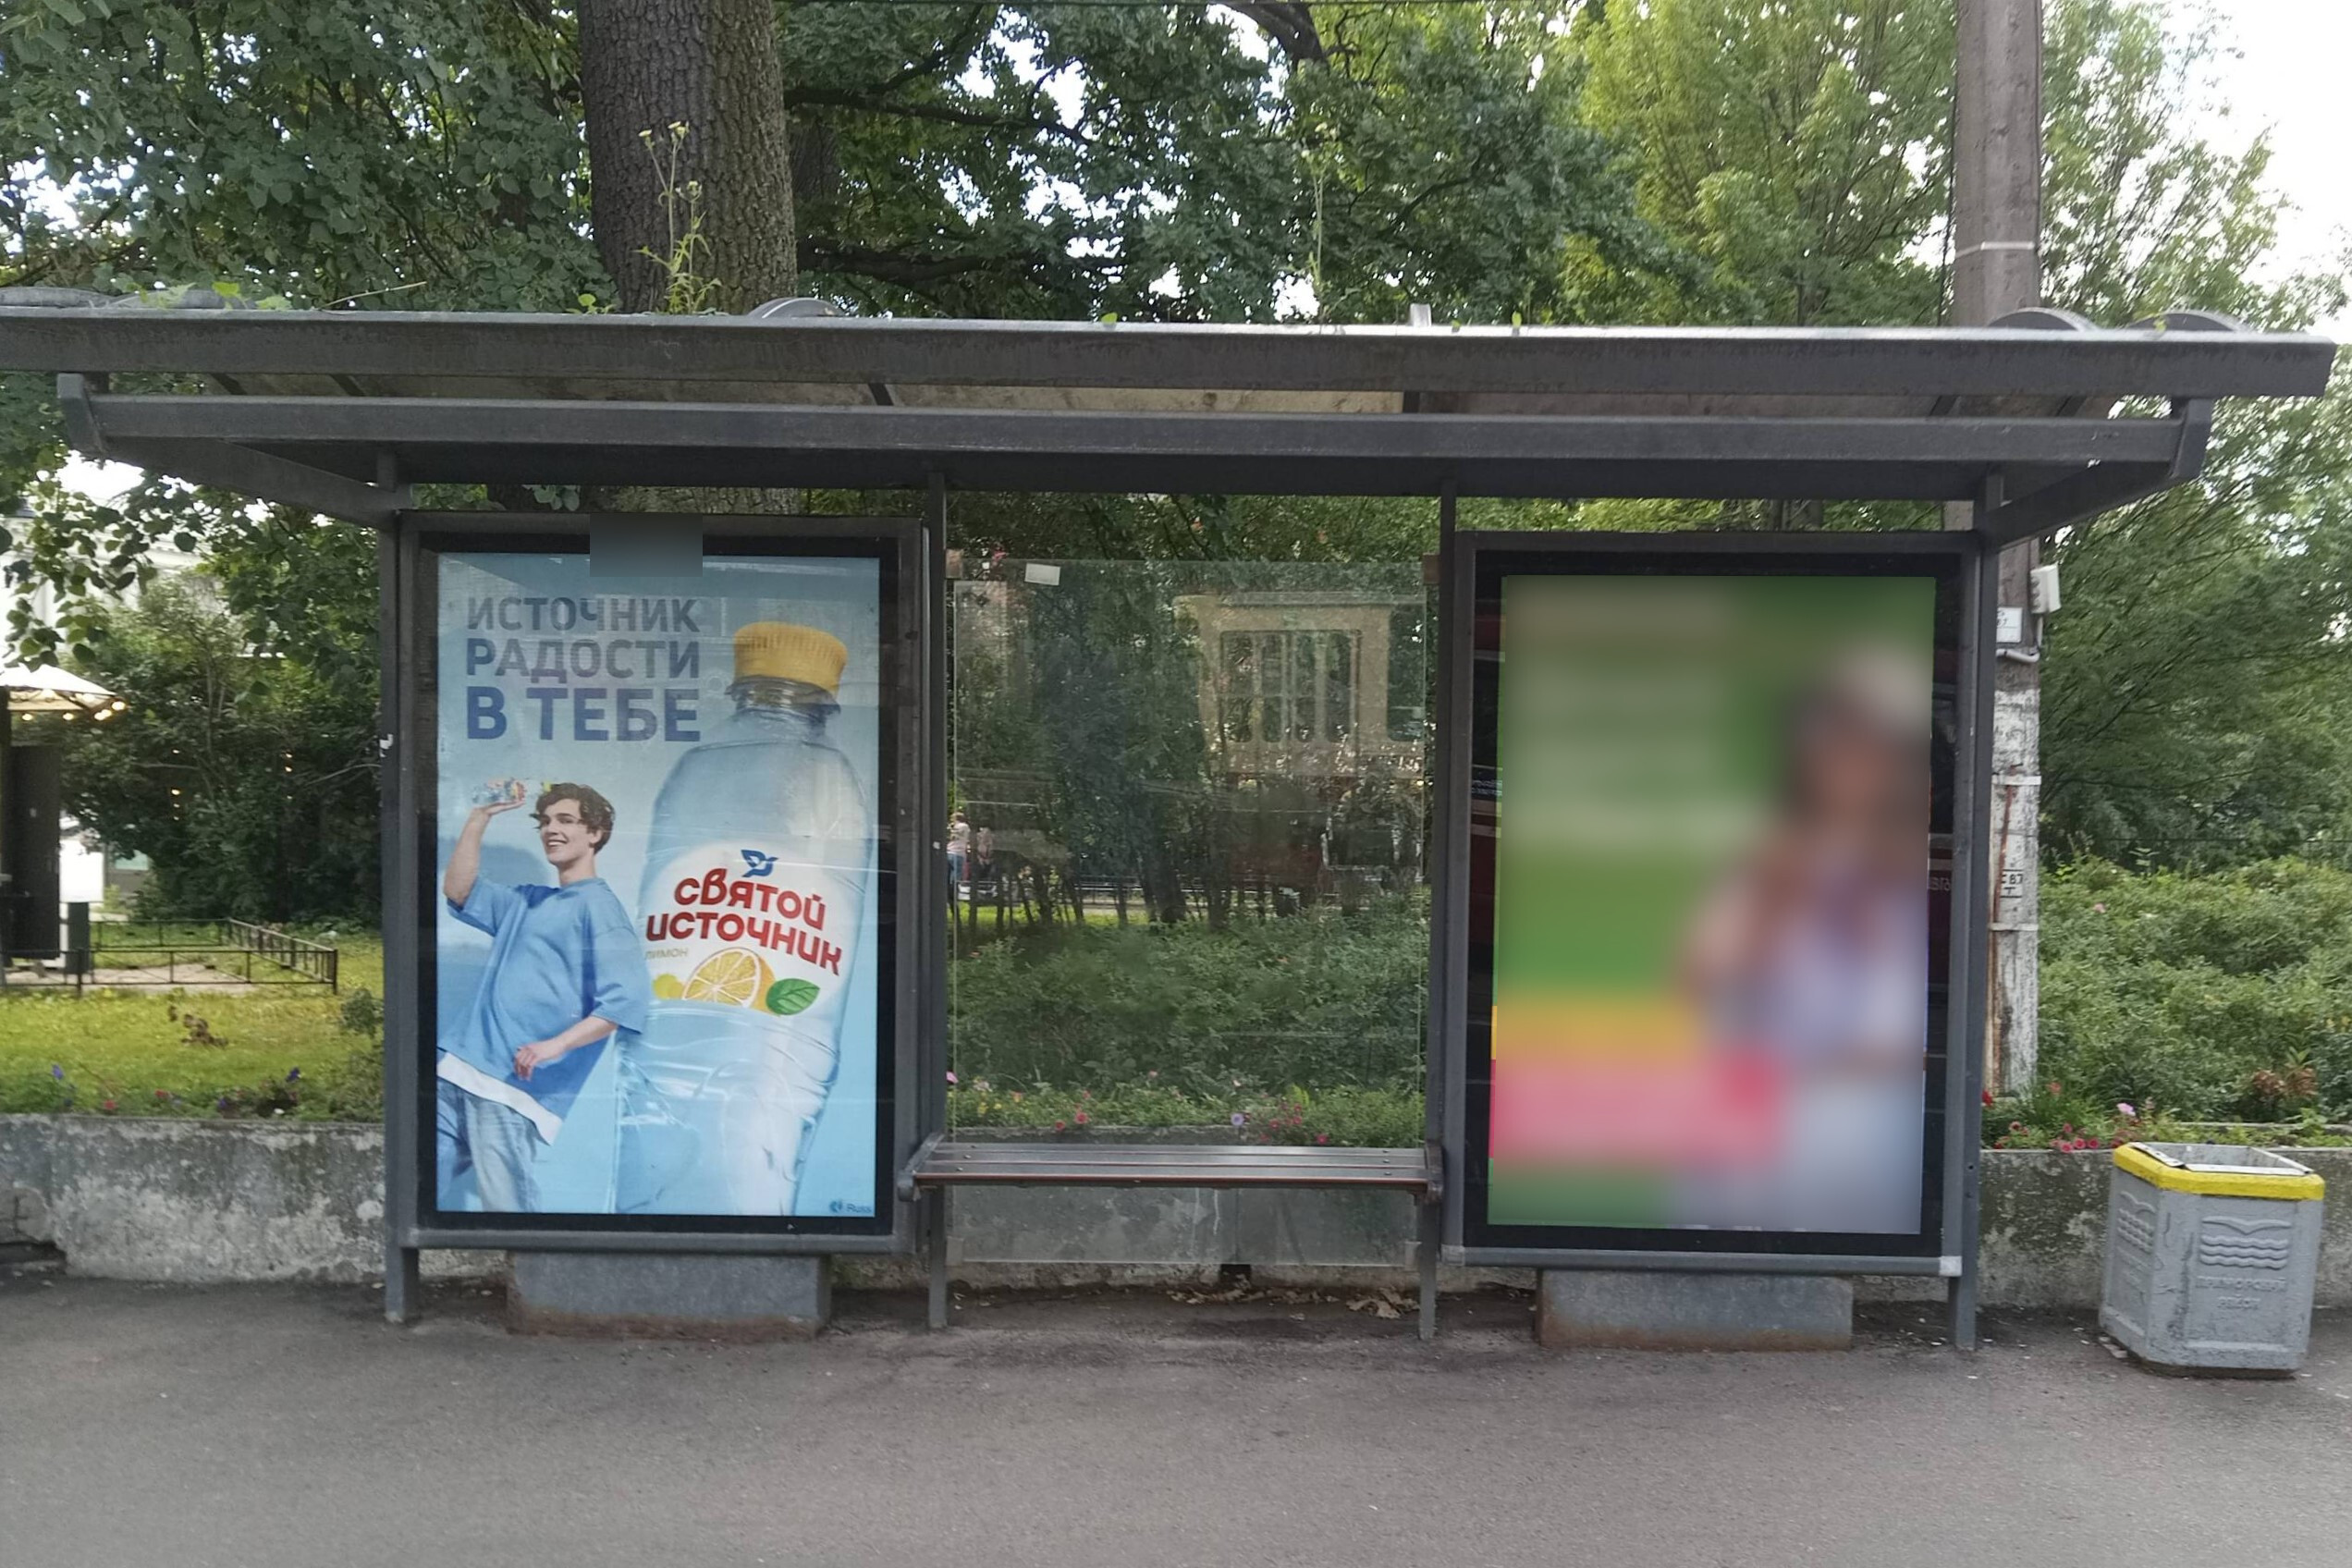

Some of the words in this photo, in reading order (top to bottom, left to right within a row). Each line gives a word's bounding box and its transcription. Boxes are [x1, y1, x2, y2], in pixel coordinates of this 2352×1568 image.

[466, 597, 700, 632] ИСТОЧНИК
[466, 638, 700, 683] РАДОСТИ
[466, 686, 507, 741] В
[526, 688, 701, 741] ТЕБЕ
